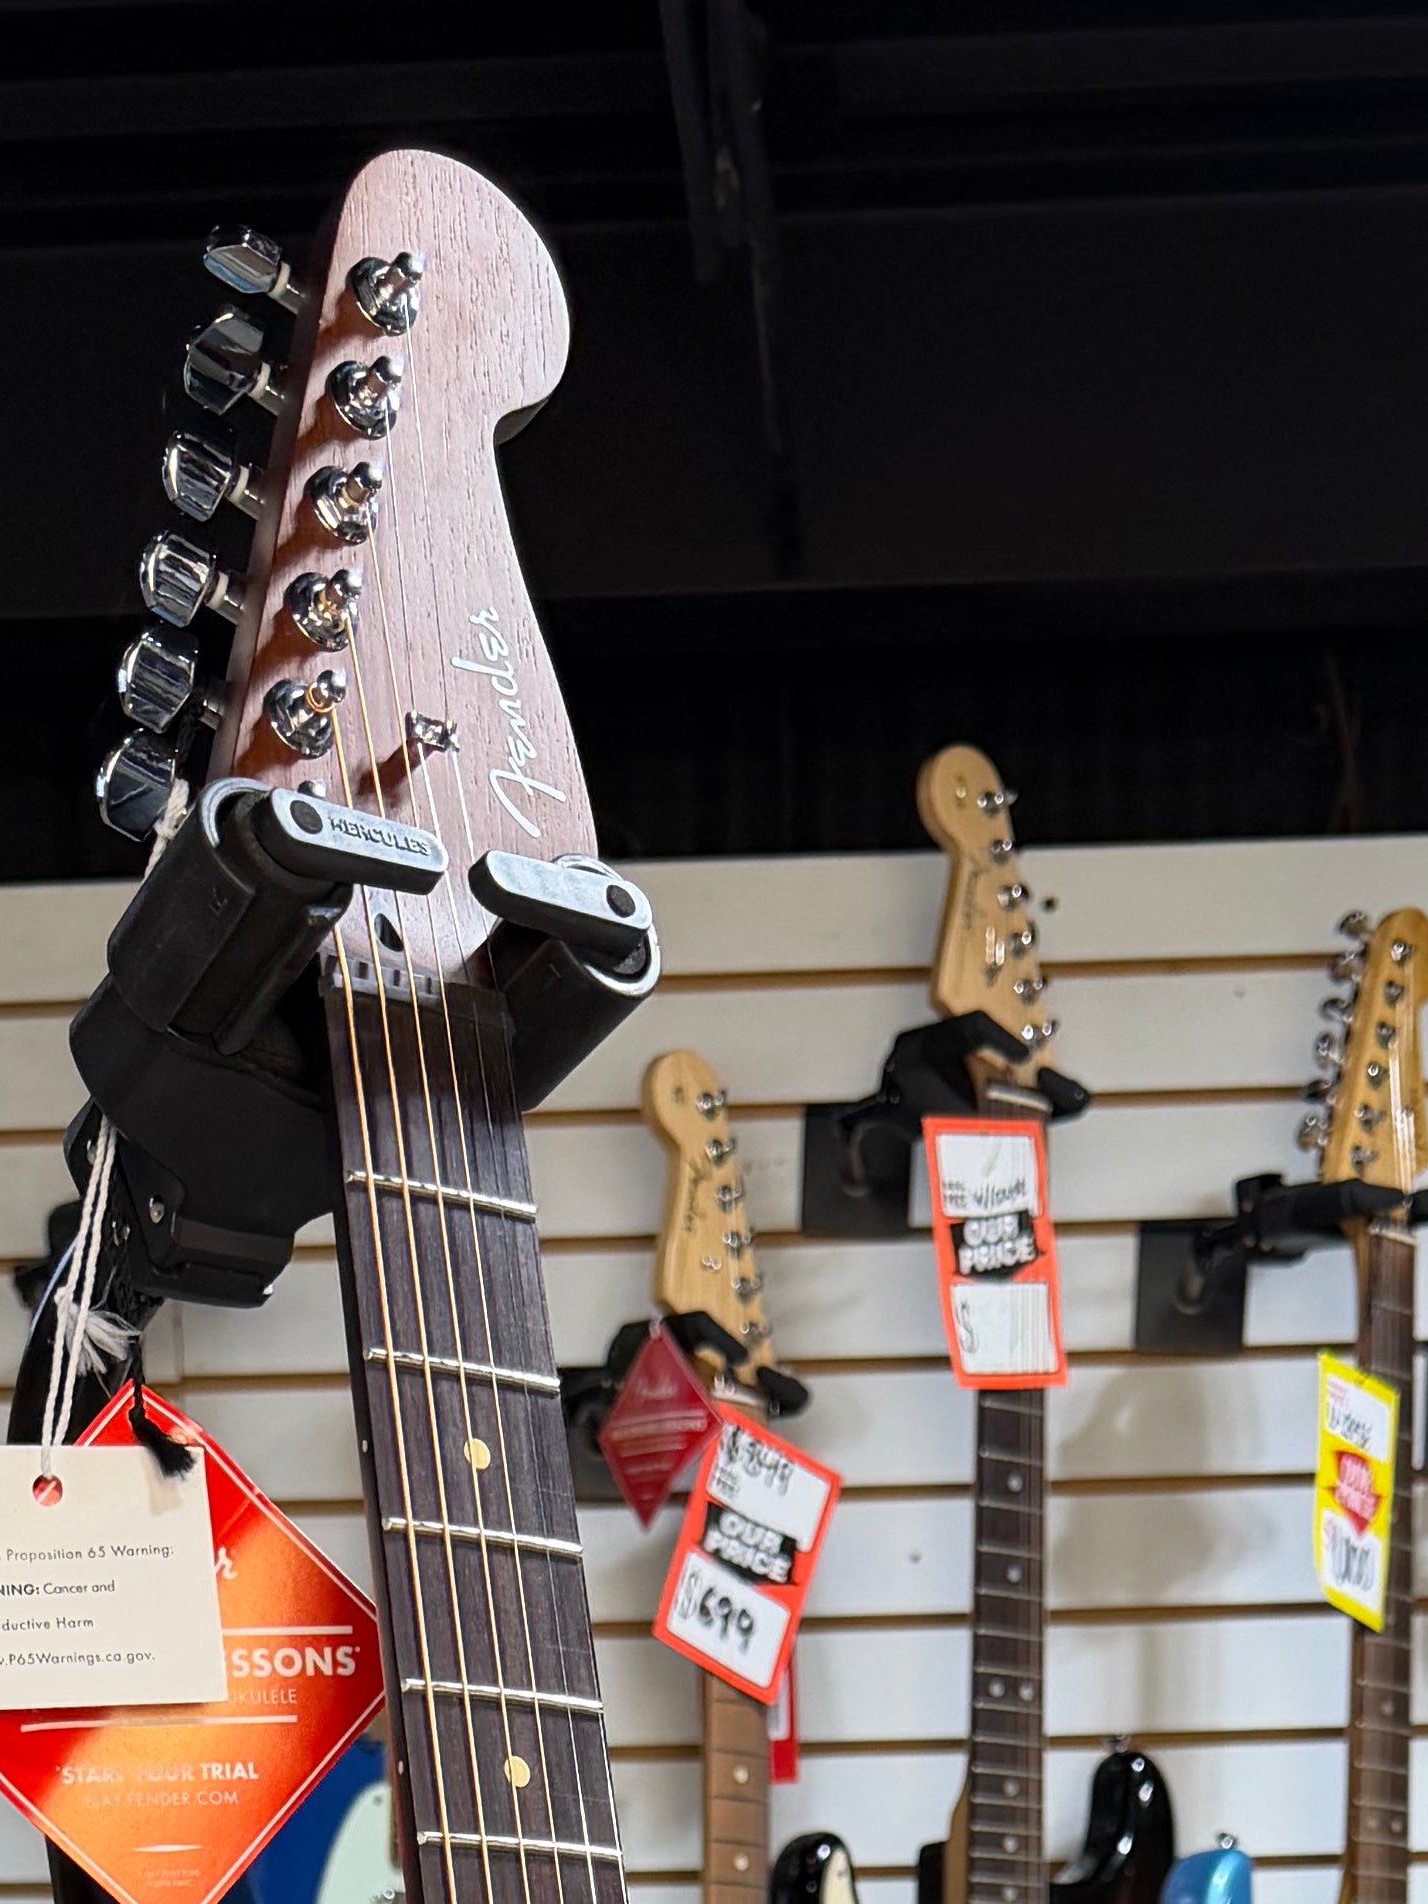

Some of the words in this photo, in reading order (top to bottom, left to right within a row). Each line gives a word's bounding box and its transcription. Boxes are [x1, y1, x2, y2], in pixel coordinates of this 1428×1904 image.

[451, 606, 567, 839] Fender
[329, 815, 430, 858] HERCULES
[719, 1511, 783, 1553] OUR
[6, 1548, 83, 1565] Proposition
[88, 1545, 106, 1559] 65
[111, 1544, 175, 1560] Warning:
[706, 1529, 791, 1583] PRICE
[43, 1583, 88, 1596] Cancer
[92, 1580, 115, 1593] and
[56, 1617, 94, 1630] Harm
[230, 1646, 357, 1678] SSONS
[199, 1762, 260, 1781] TRIAL
